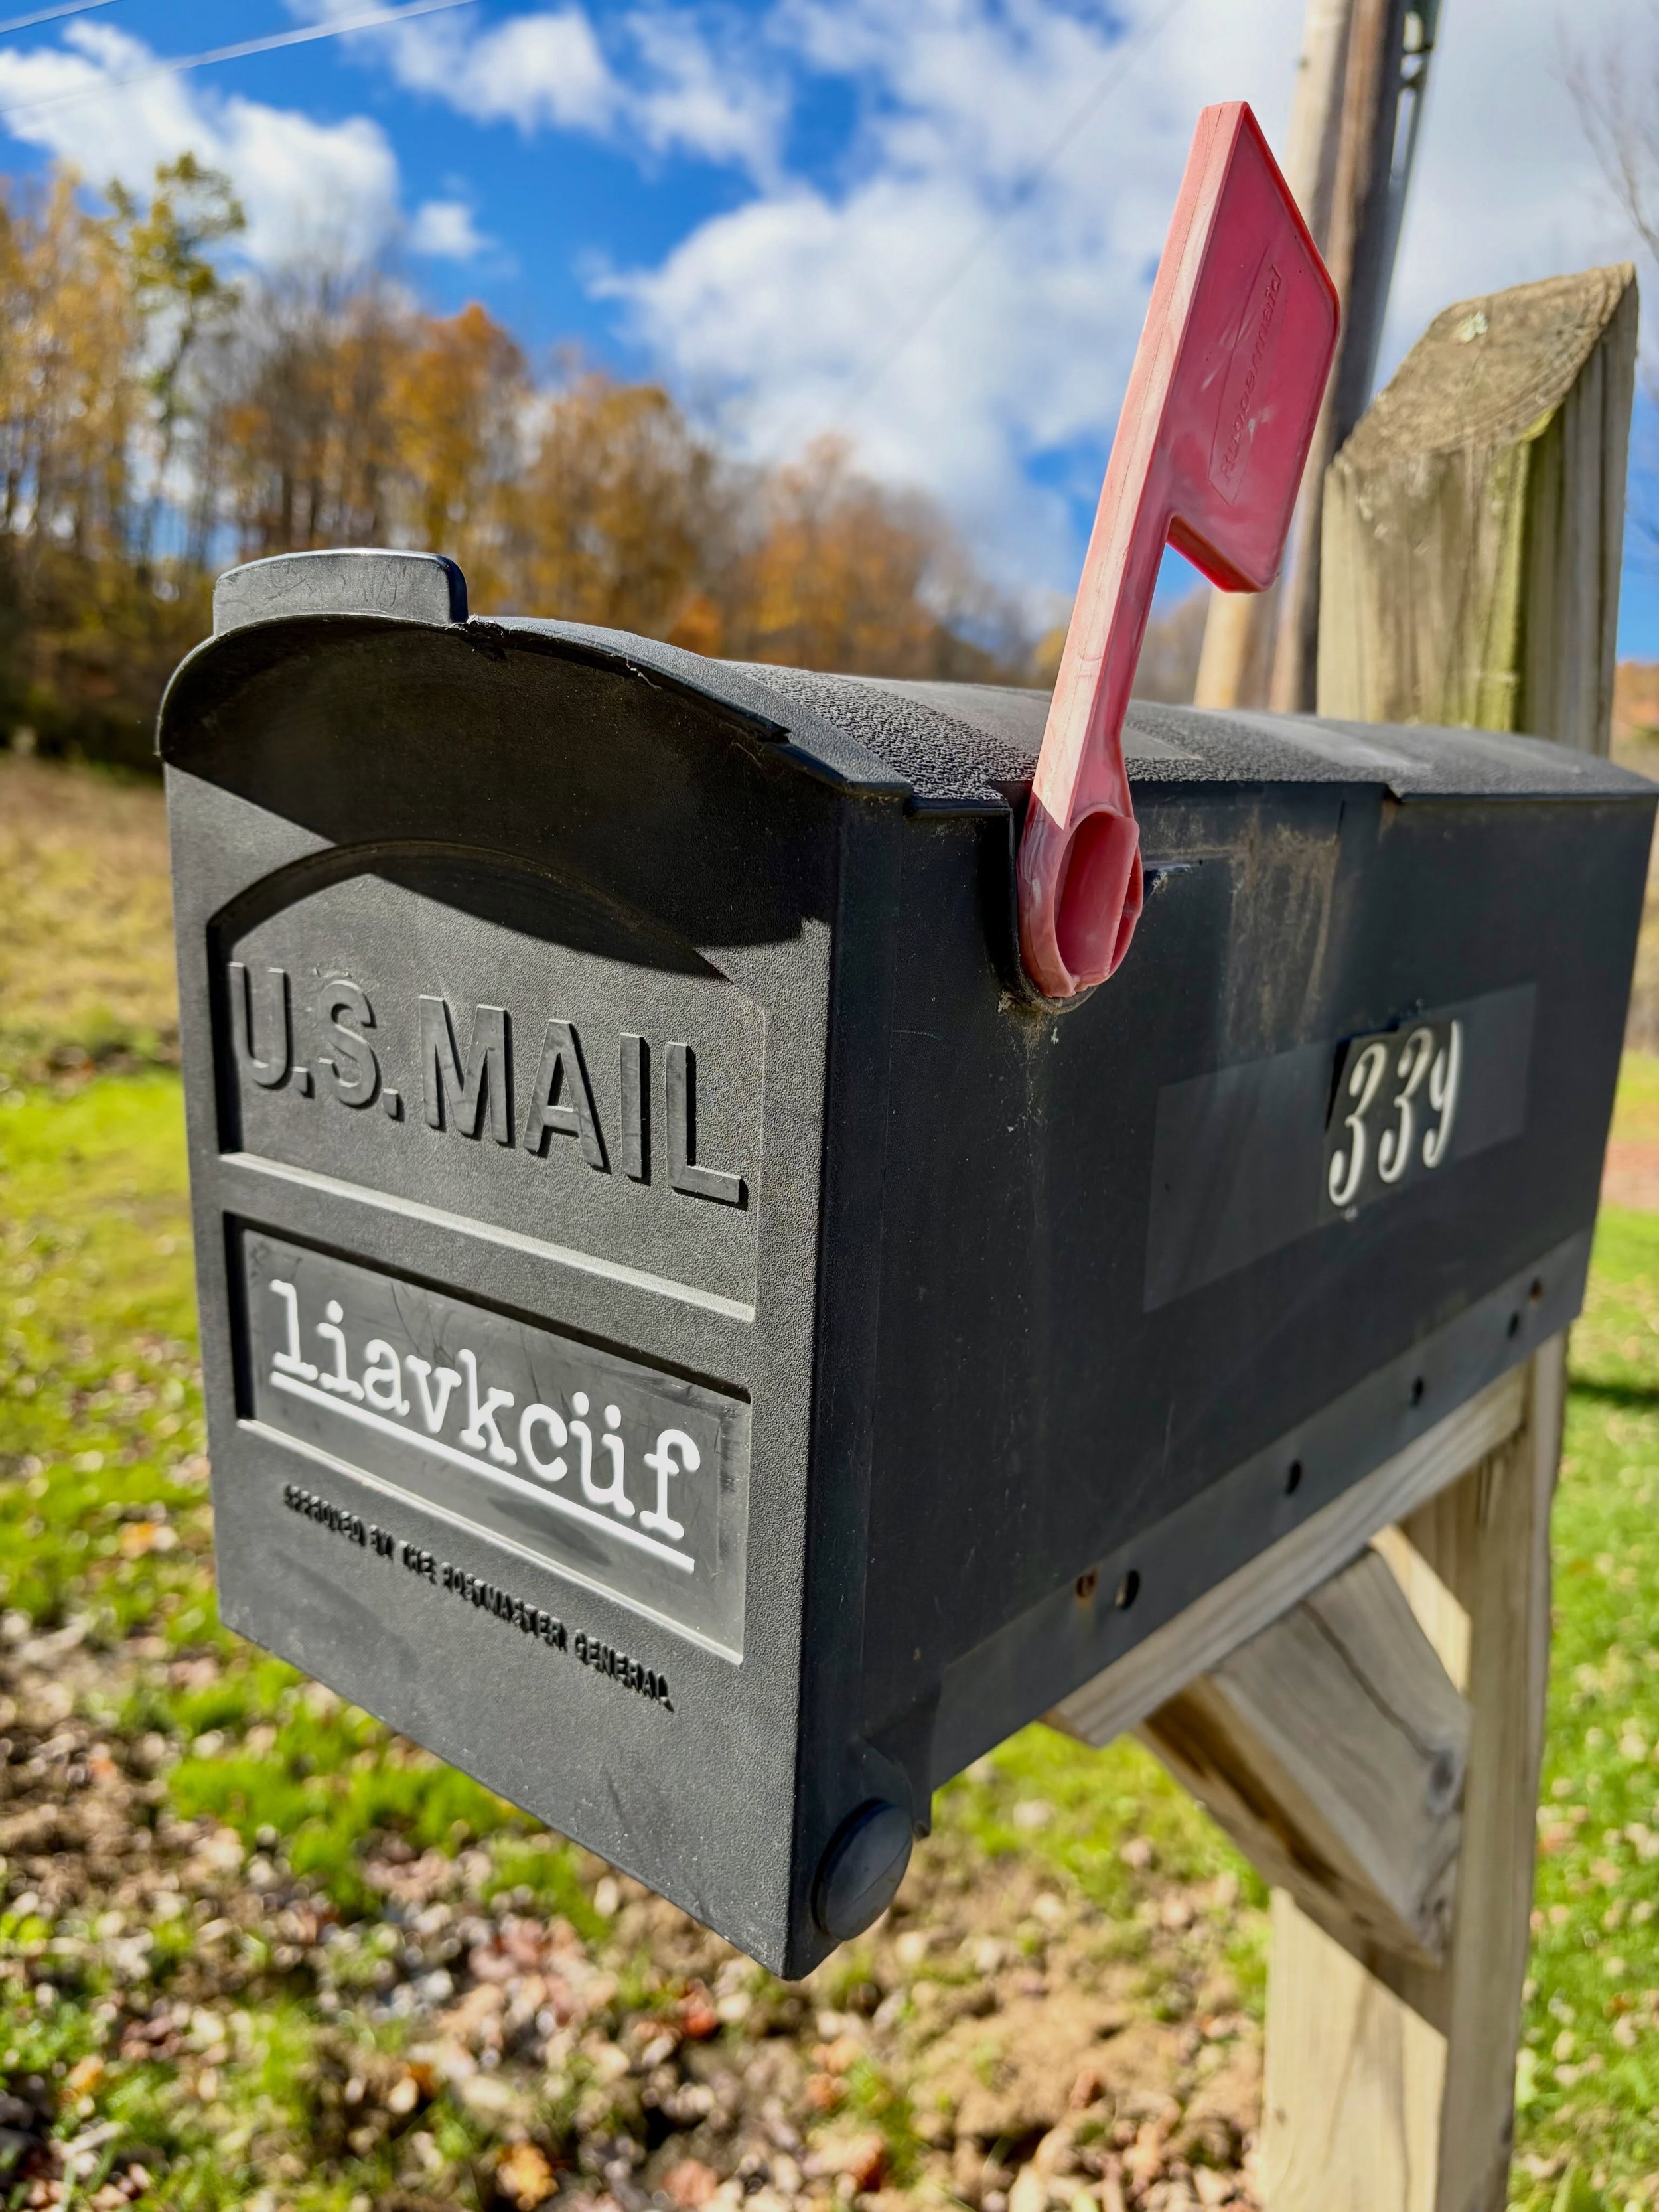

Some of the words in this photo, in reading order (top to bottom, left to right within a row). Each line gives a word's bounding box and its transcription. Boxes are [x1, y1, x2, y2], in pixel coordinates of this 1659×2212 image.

[1220, 263, 1282, 480] Rubbermaid
[228, 961, 402, 1120] U.S.
[418, 994, 746, 1209] MAIL
[1329, 1019, 1462, 1206] 339
[269, 1279, 701, 1540] liavkcüf
[440, 1561, 567, 1653] POSTMASTER
[575, 1629, 674, 1712] GENERAL
